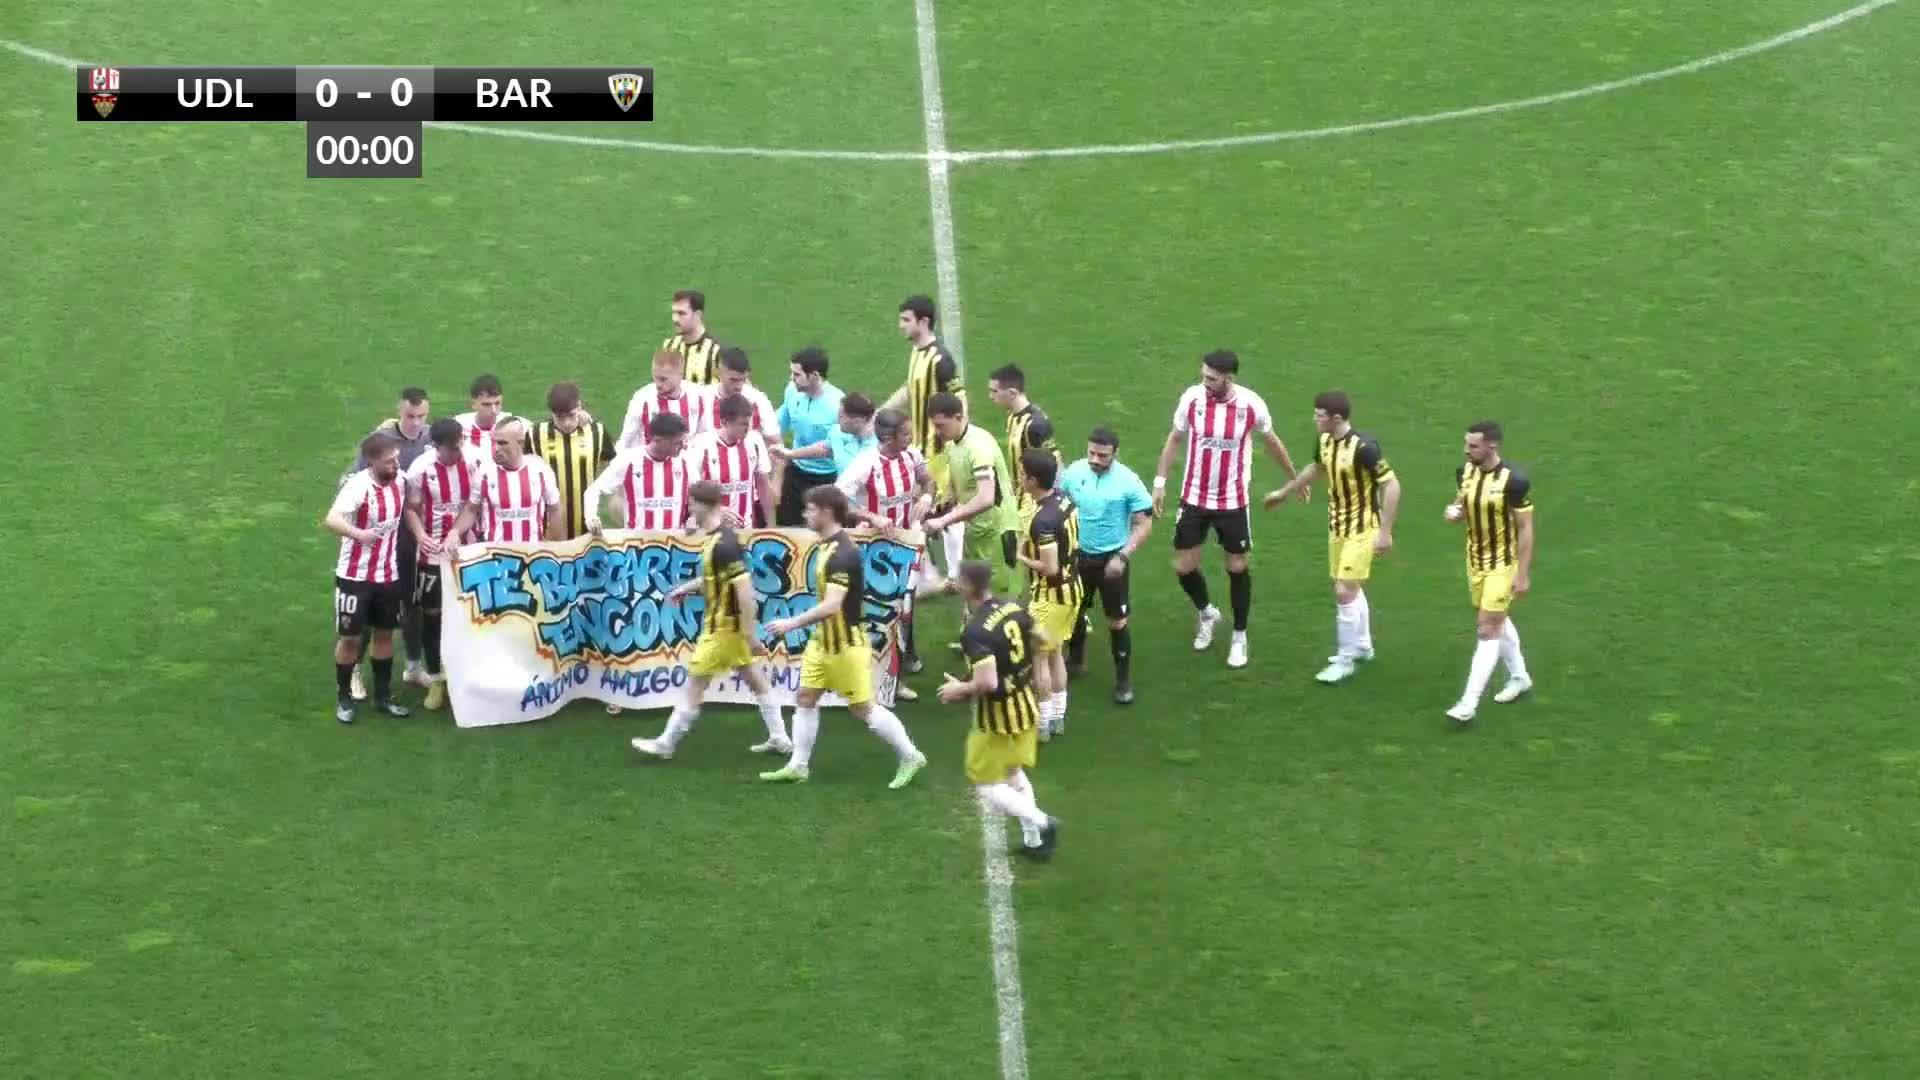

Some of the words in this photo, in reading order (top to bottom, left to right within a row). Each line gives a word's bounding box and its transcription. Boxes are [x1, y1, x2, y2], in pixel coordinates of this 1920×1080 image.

[461, 553, 534, 615] TE
[527, 546, 790, 612] BUSCARES
[339, 592, 358, 614] 10
[1003, 620, 1025, 664] 3
